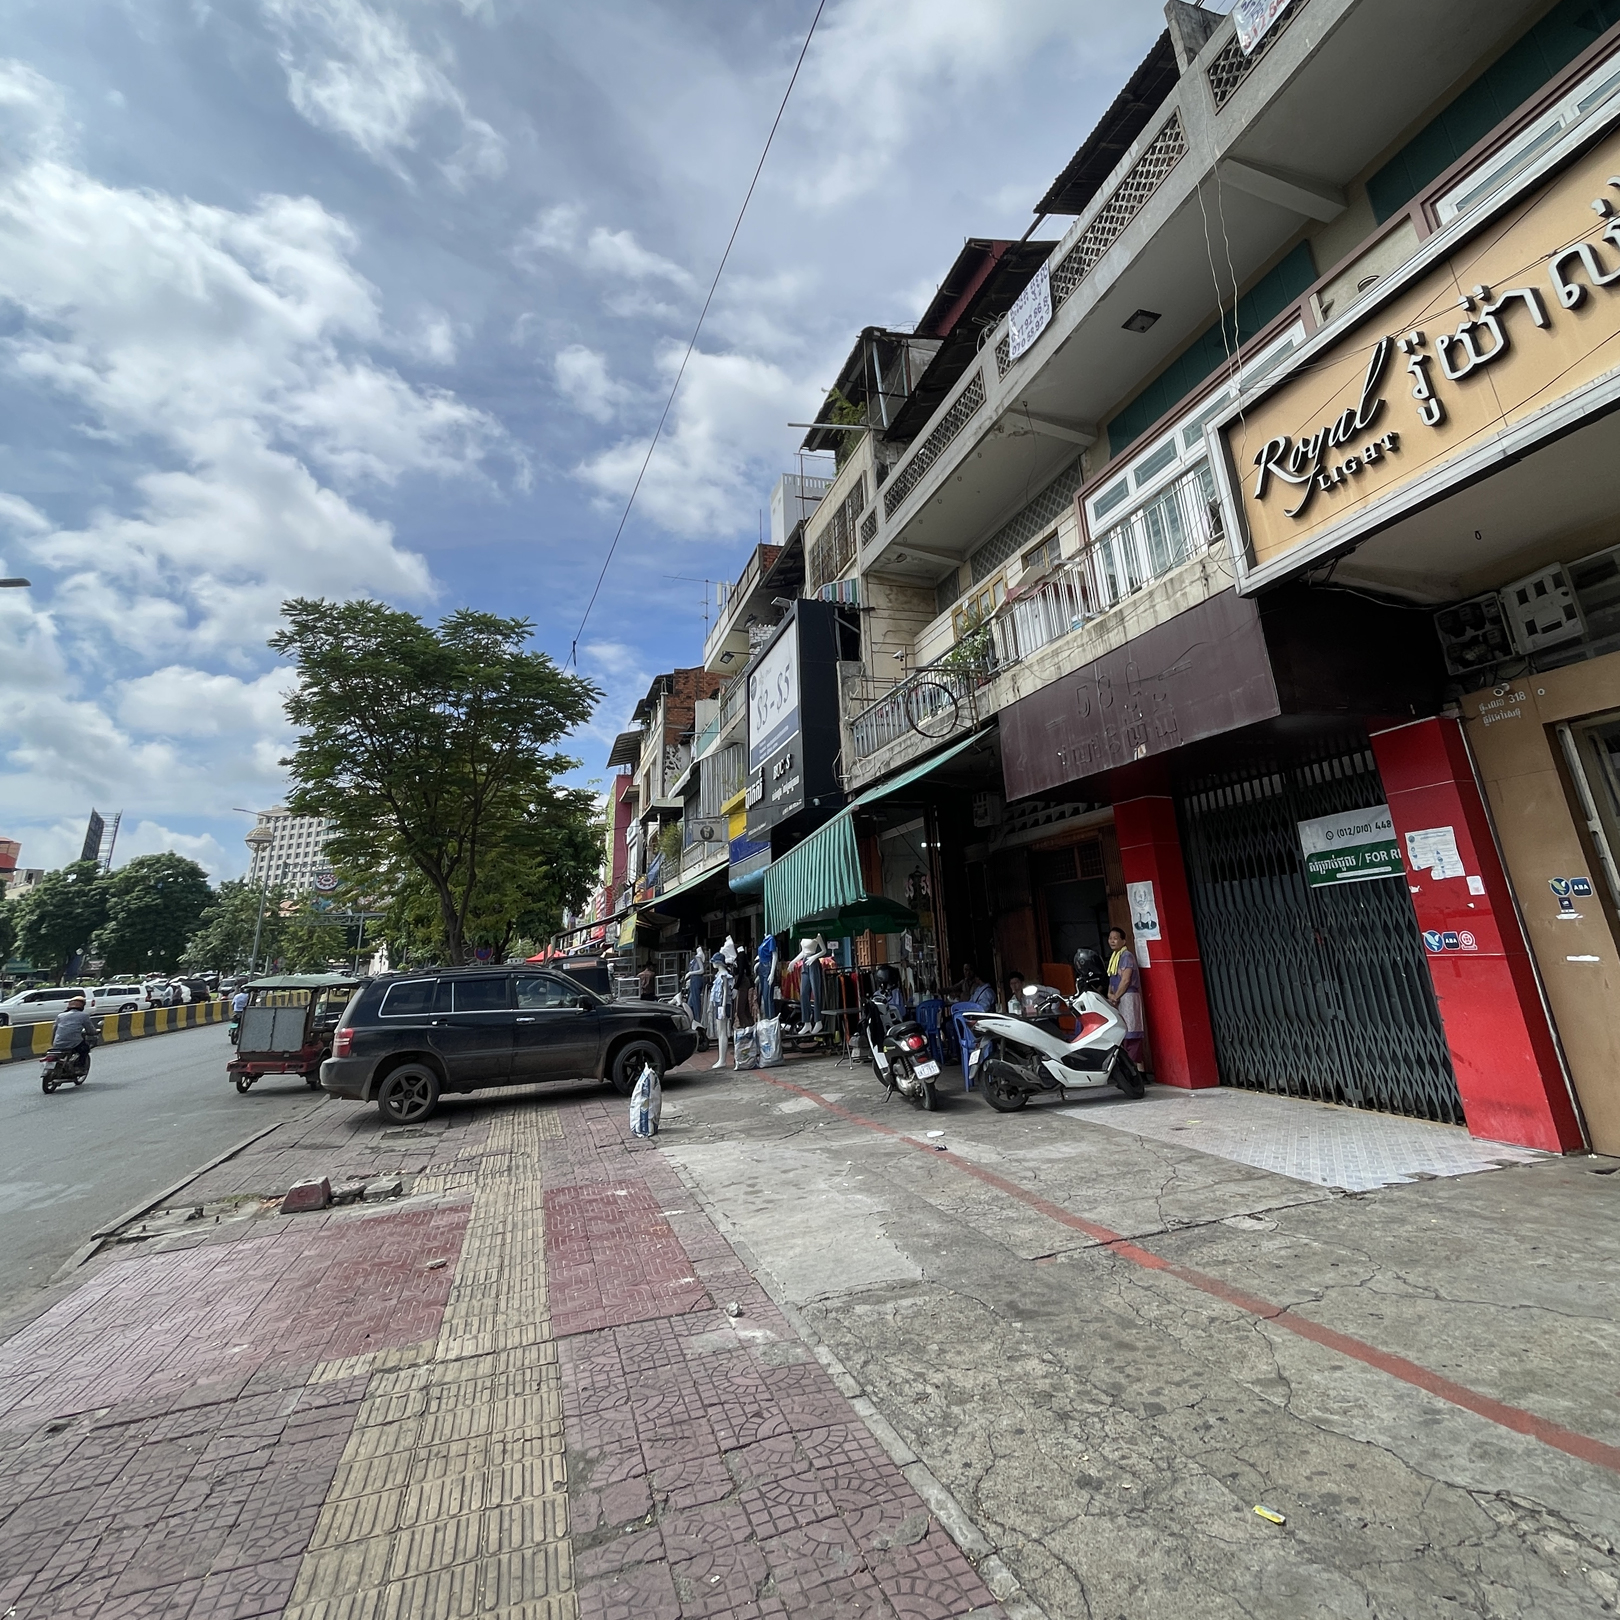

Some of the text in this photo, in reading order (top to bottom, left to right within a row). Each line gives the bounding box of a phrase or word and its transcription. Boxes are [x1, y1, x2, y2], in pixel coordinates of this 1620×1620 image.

[1253, 335, 1392, 517] Royal
[1316, 431, 1400, 492] LIGHT
[1507, 691, 1526, 704] 318
[1336, 819, 1392, 839] (012/010) 448
[1364, 850, 1389, 864] FOR
